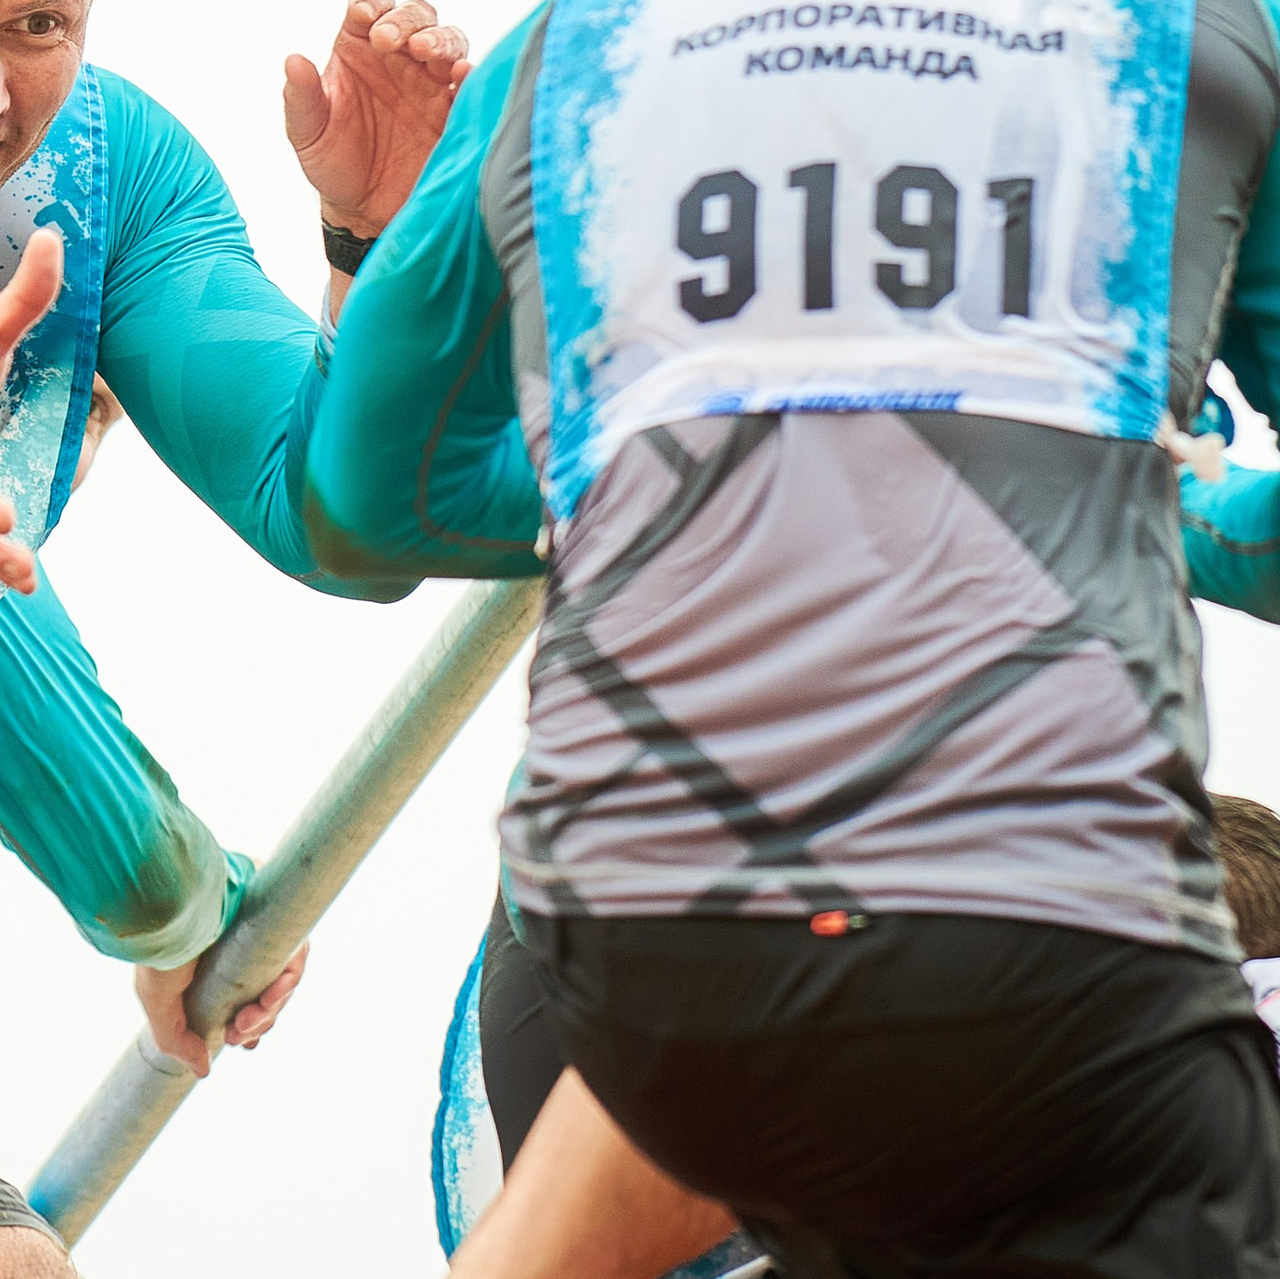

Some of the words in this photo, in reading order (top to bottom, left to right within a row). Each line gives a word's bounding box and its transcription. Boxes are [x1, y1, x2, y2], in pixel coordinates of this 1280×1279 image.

[672, 4, 1066, 56] КОРПОРАТИВНАЯ
[744, 45, 980, 82] КОМАНДА
[678, 162, 1034, 322] 9191
